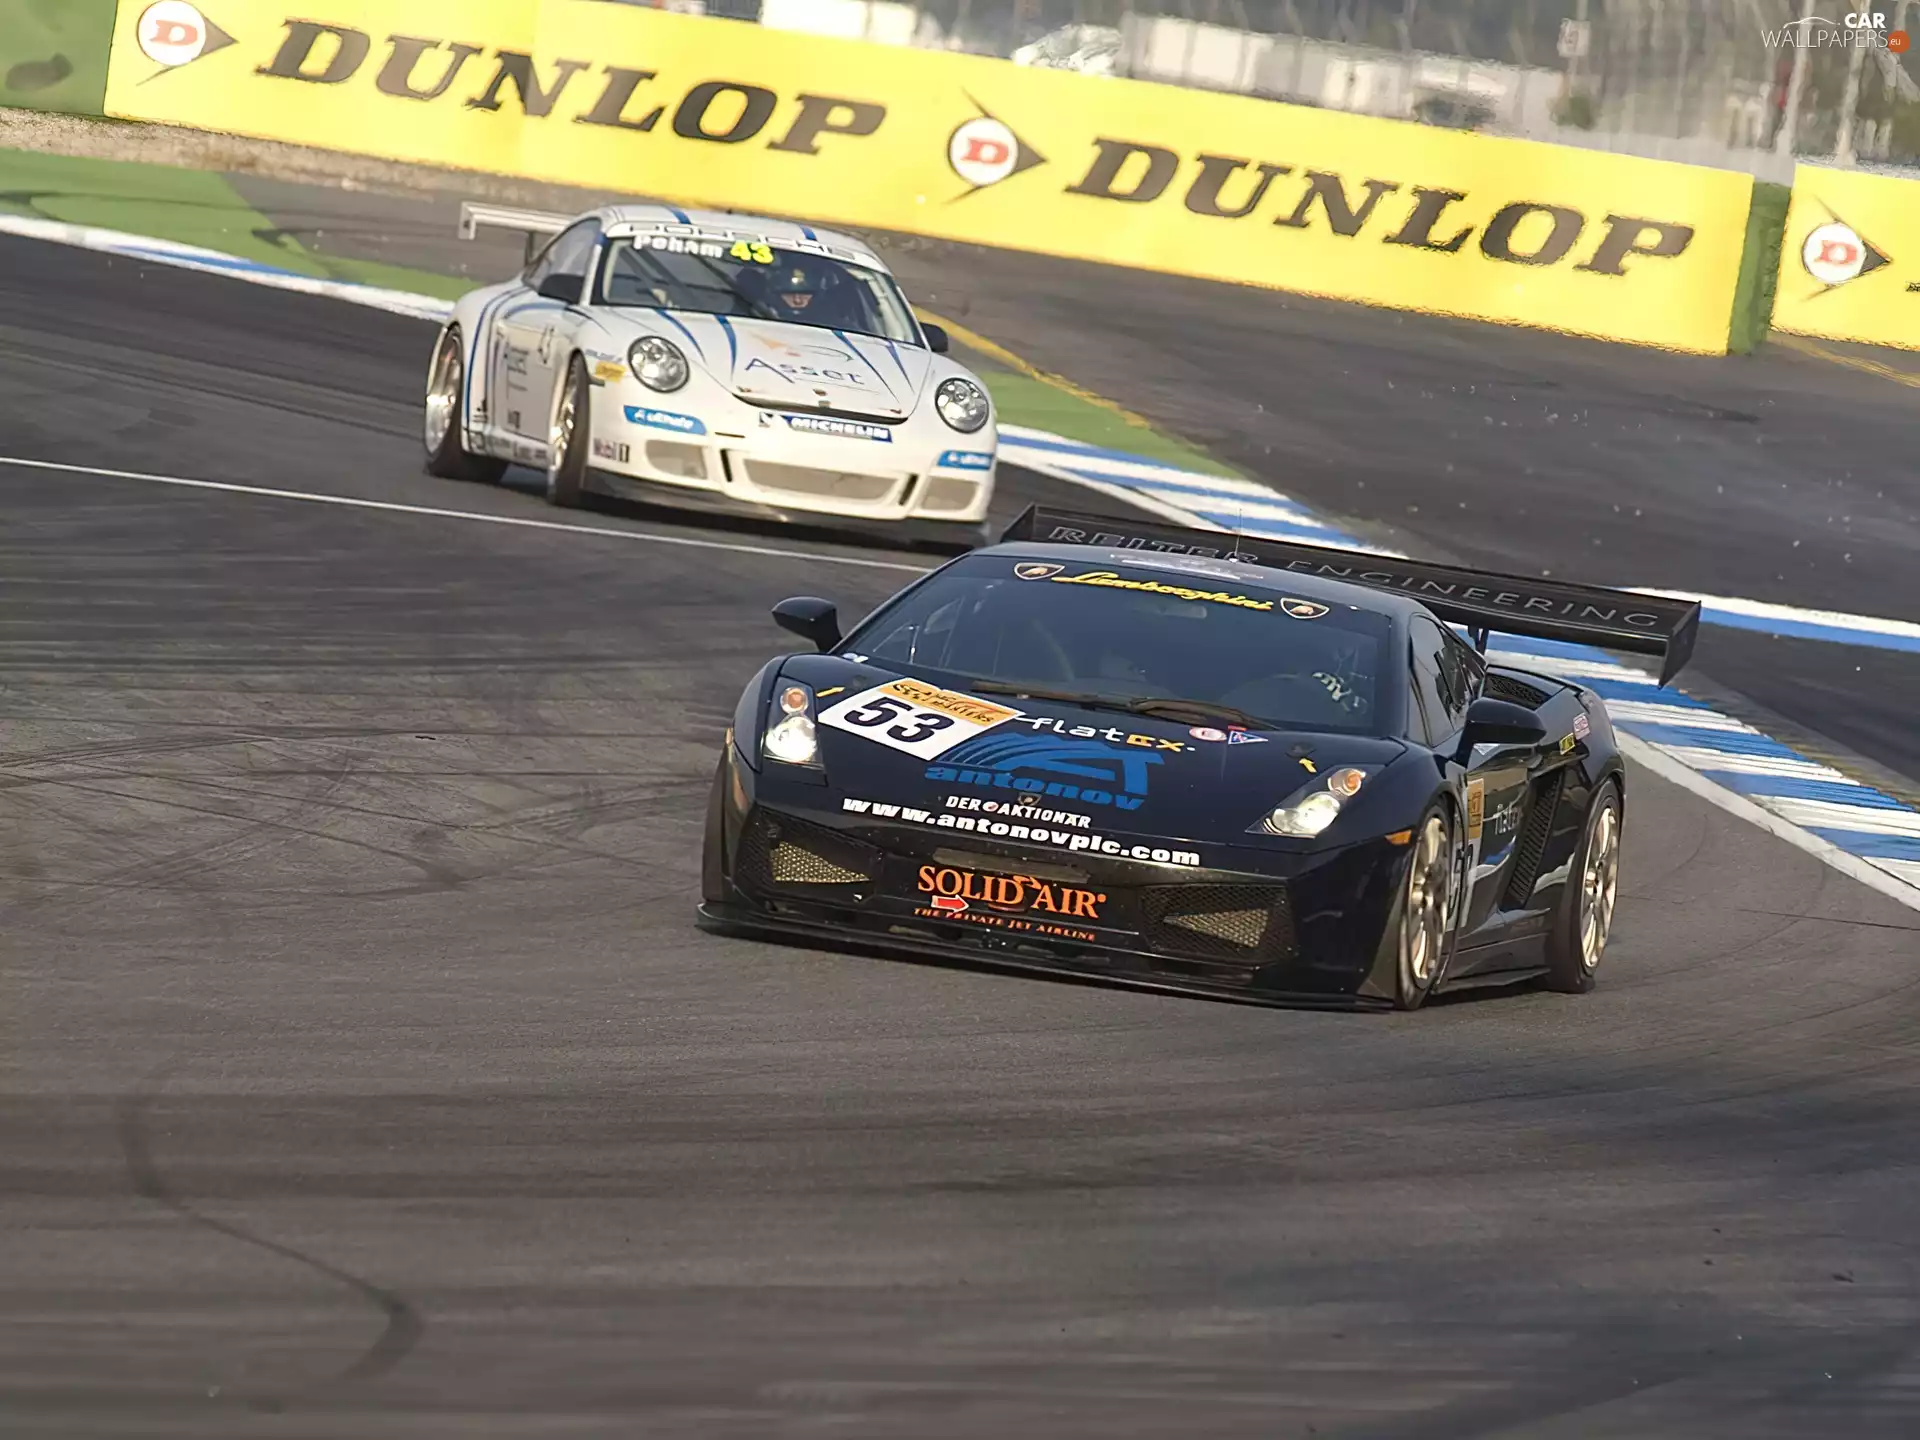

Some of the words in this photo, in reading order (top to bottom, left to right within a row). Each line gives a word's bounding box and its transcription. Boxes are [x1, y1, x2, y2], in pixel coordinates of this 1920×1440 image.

[254, 16, 887, 155] DUNLOP
[1065, 137, 1696, 277] DUNLOP
[729, 239, 775, 265] 43
[790, 415, 890, 440] MICHELIN
[1051, 572, 1275, 611] Lamborghini
[1286, 560, 1659, 628] ENGINEERING
[843, 696, 955, 744] 53
[924, 765, 1146, 811] antonov
[945, 795, 982, 812] DER
[842, 798, 1201, 867] www.antonovplc.com
[917, 865, 1025, 906] SOLID
[913, 907, 941, 918] THE
[1008, 919, 1032, 931] JET
[1036, 923, 1097, 942] AIRLINE
